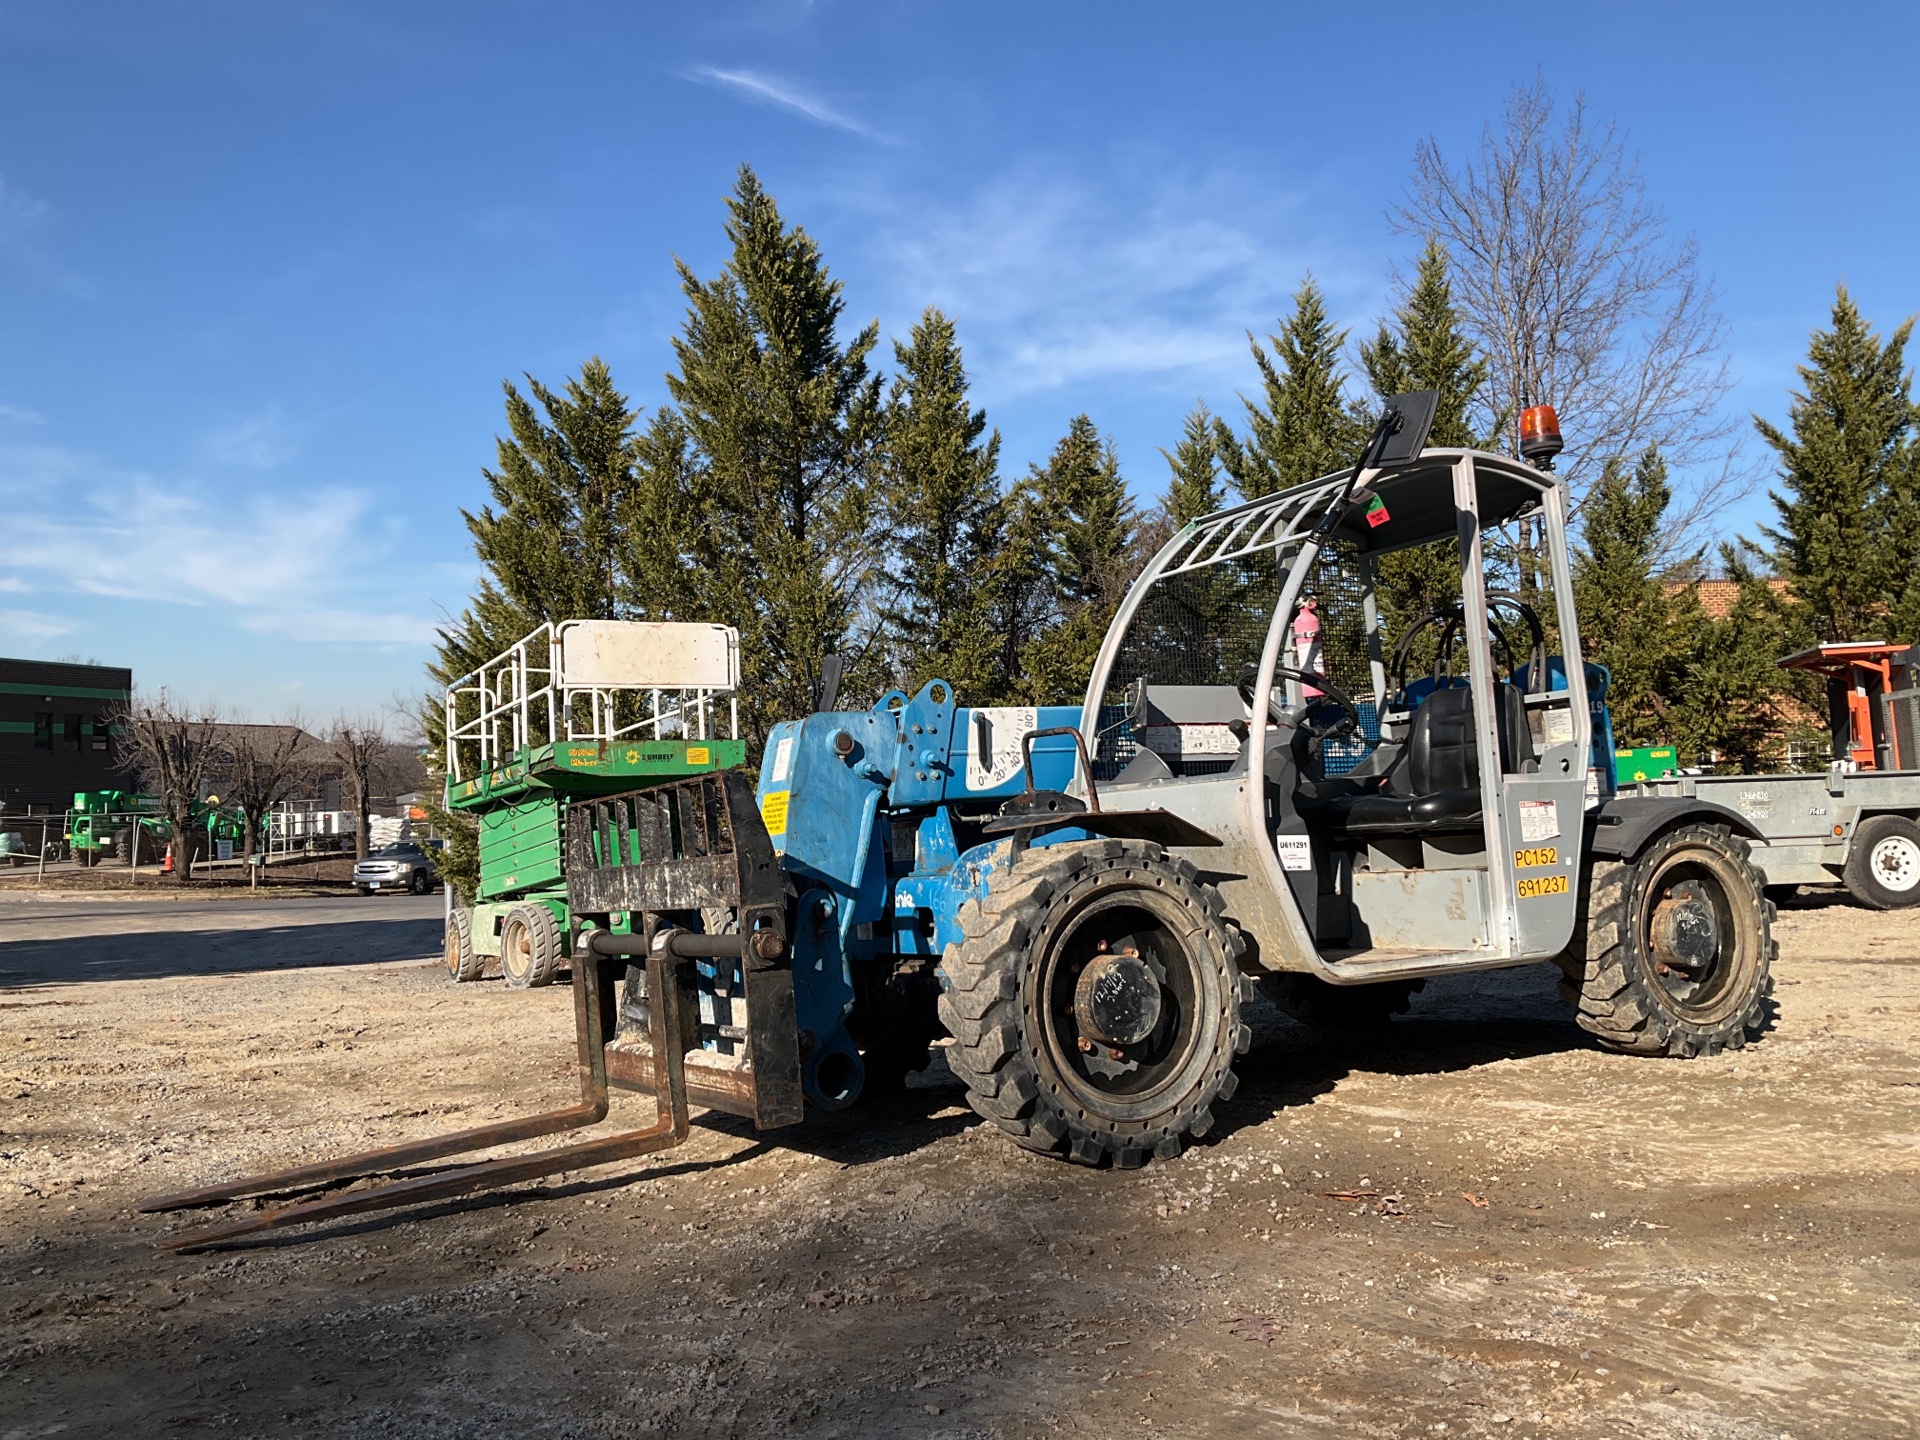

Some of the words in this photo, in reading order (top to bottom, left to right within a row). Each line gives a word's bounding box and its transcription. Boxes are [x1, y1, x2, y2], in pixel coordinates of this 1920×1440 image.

[1590, 701, 1604, 713] 19
[1280, 841, 1308, 849] U611291
[1515, 848, 1557, 867] PC152
[1518, 875, 1567, 897] 691237
